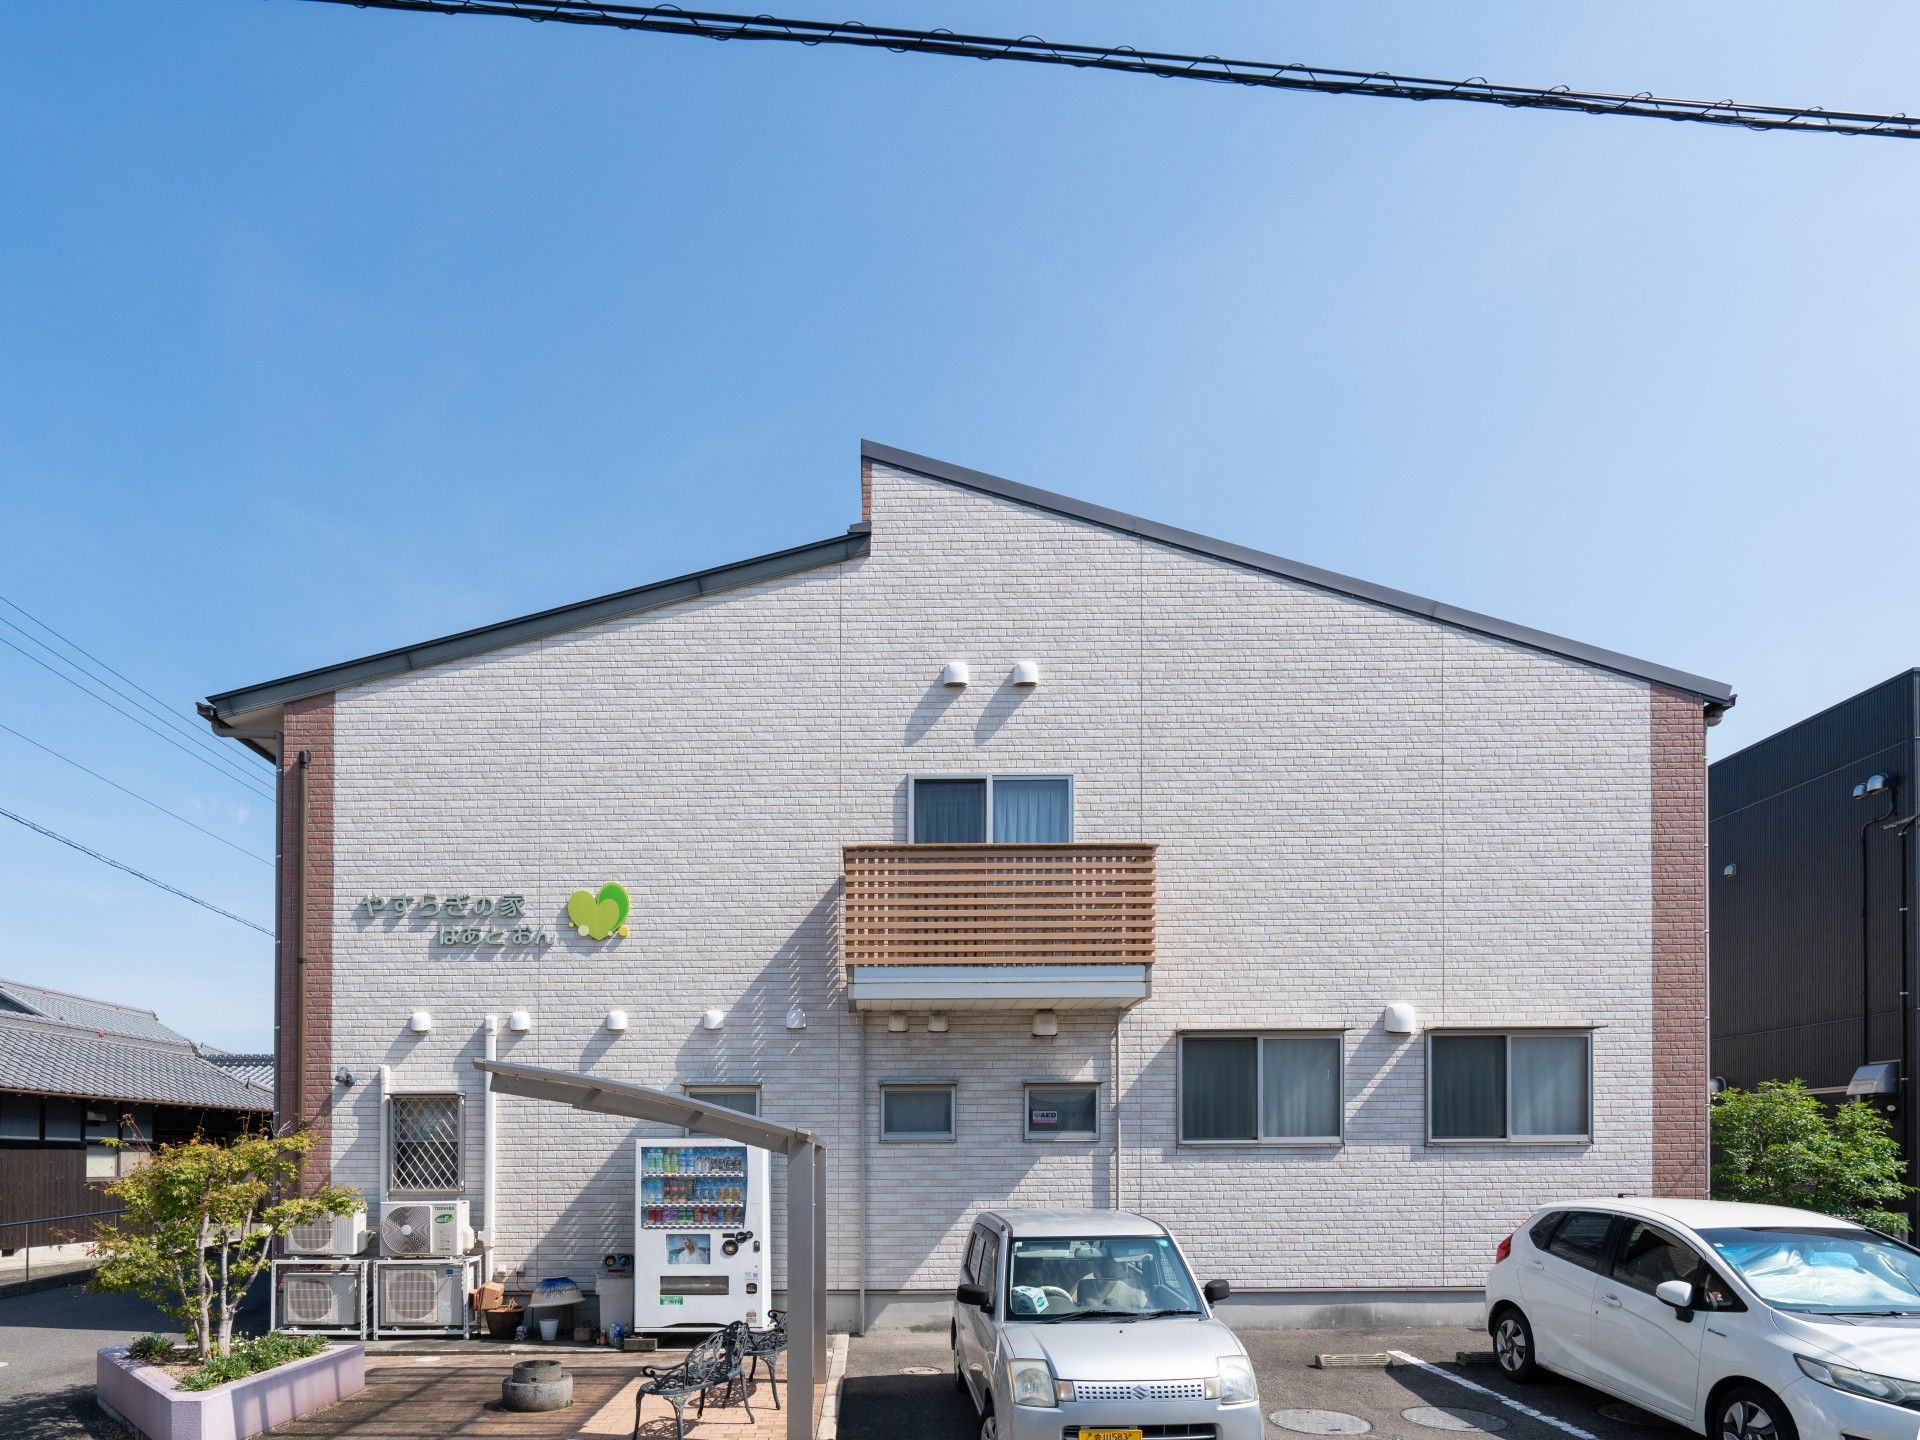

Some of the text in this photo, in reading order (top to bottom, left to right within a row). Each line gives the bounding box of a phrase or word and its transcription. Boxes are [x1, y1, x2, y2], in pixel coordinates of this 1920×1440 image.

[361, 891, 526, 917] やすらぎの家
